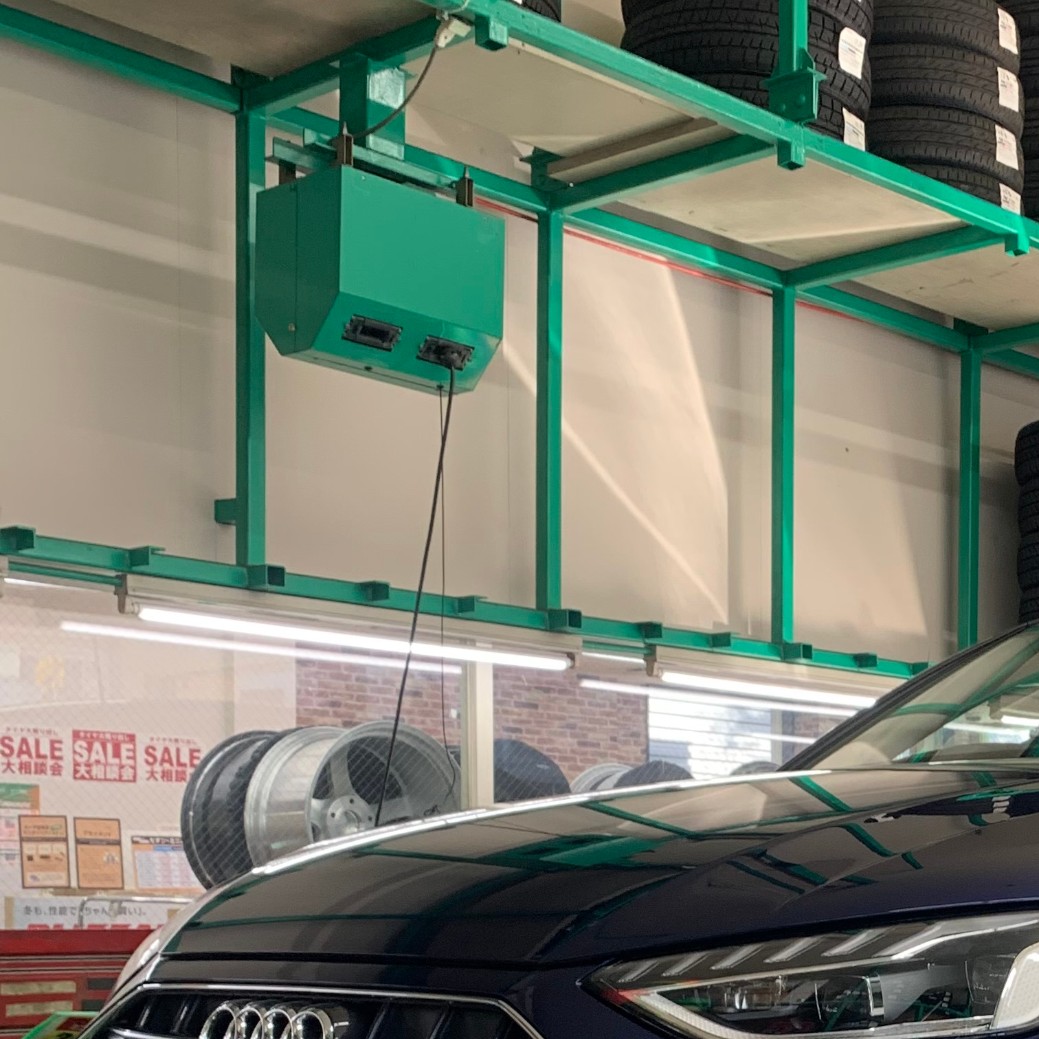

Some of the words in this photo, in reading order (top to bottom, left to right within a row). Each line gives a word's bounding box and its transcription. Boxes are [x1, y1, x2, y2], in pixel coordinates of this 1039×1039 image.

[0, 736, 63, 760] SALE
[74, 740, 134, 764] SALE
[144, 745, 201, 768] SALE
[145, 767, 192, 783] 大相談
